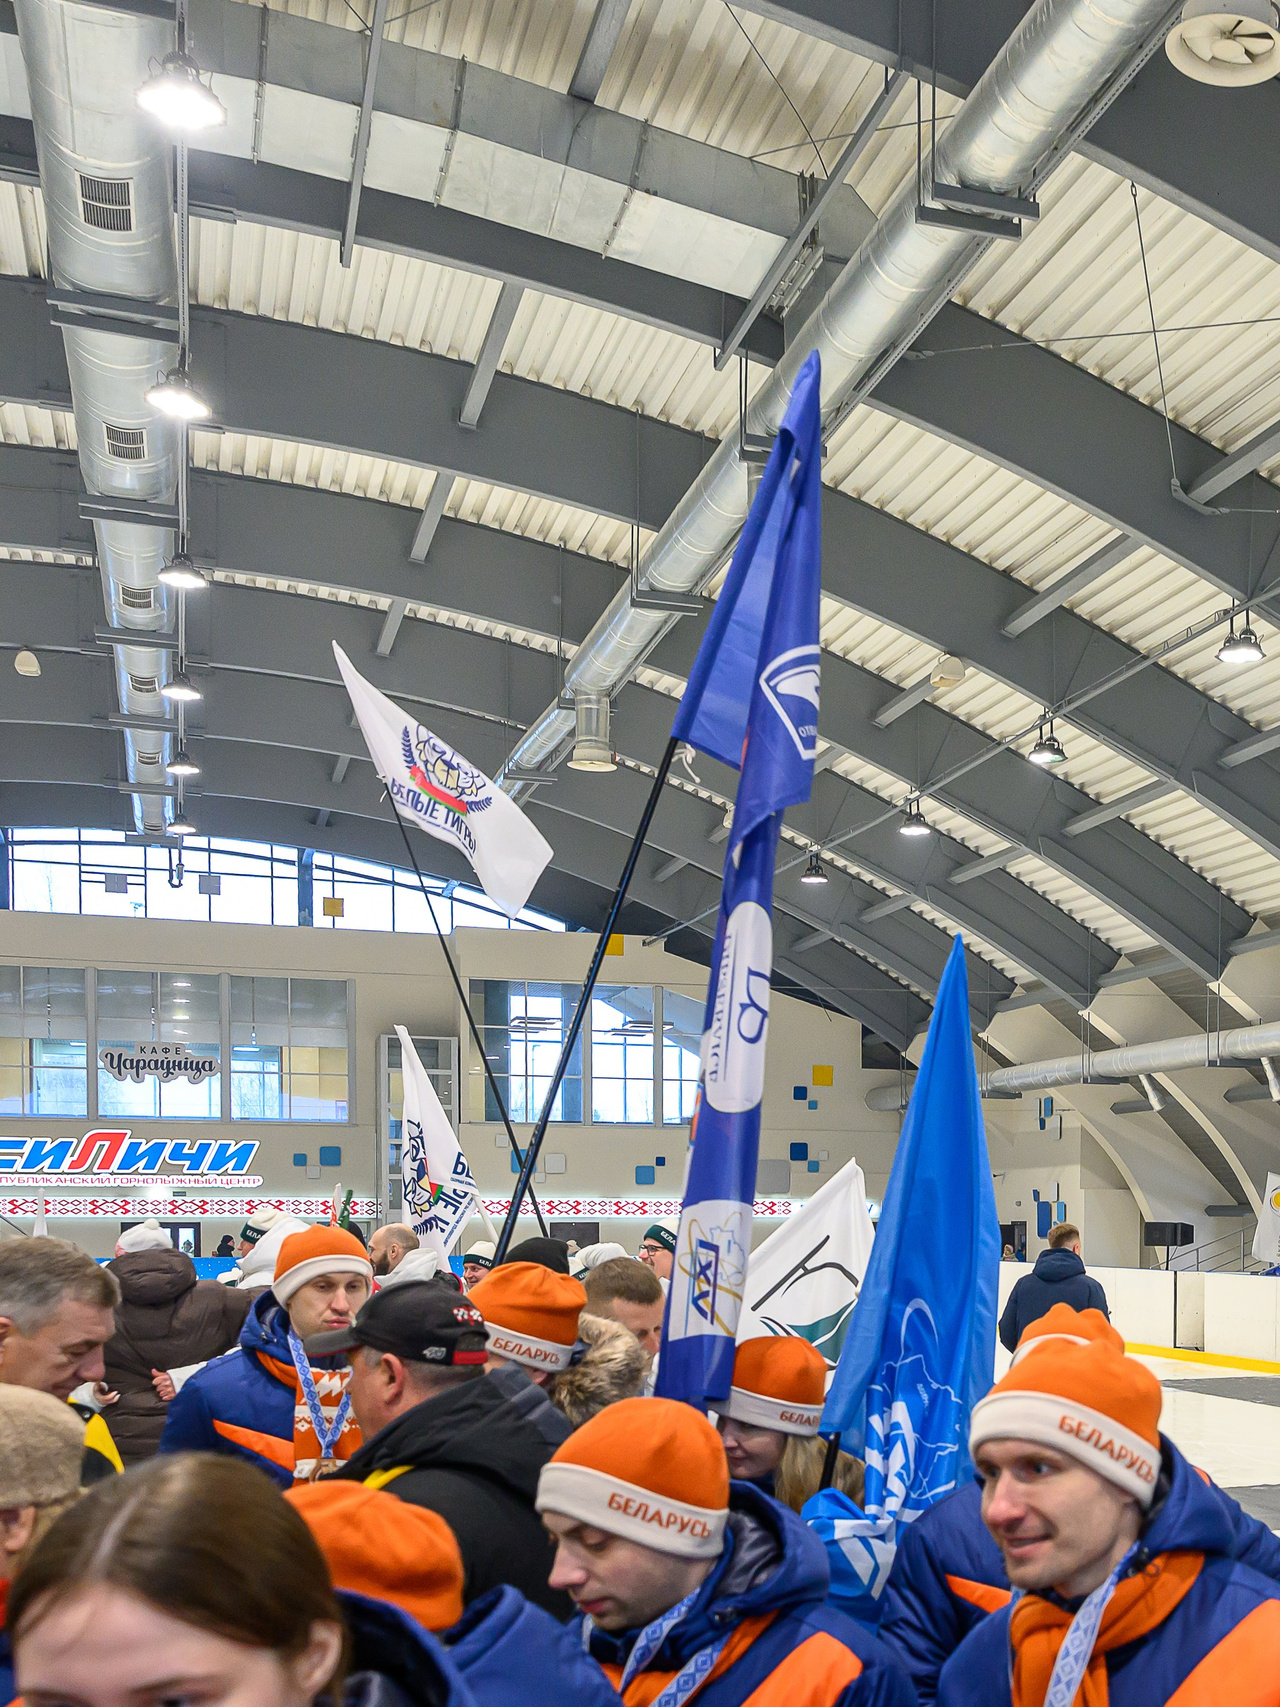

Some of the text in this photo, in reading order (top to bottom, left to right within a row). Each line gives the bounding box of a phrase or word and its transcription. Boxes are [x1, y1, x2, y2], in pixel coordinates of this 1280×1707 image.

[443, 807, 477, 853] ТИГРЫ
[140, 1046, 181, 1055] КАФЕ
[113, 1176, 218, 1185] ГОРНОЛЫЖНЫЙ
[220, 1178, 261, 1186] ЦЕНТР
[1058, 1413, 1156, 1485] БЕЛАРУСЬ
[607, 1491, 712, 1539] БЕЛАРУСЬ
